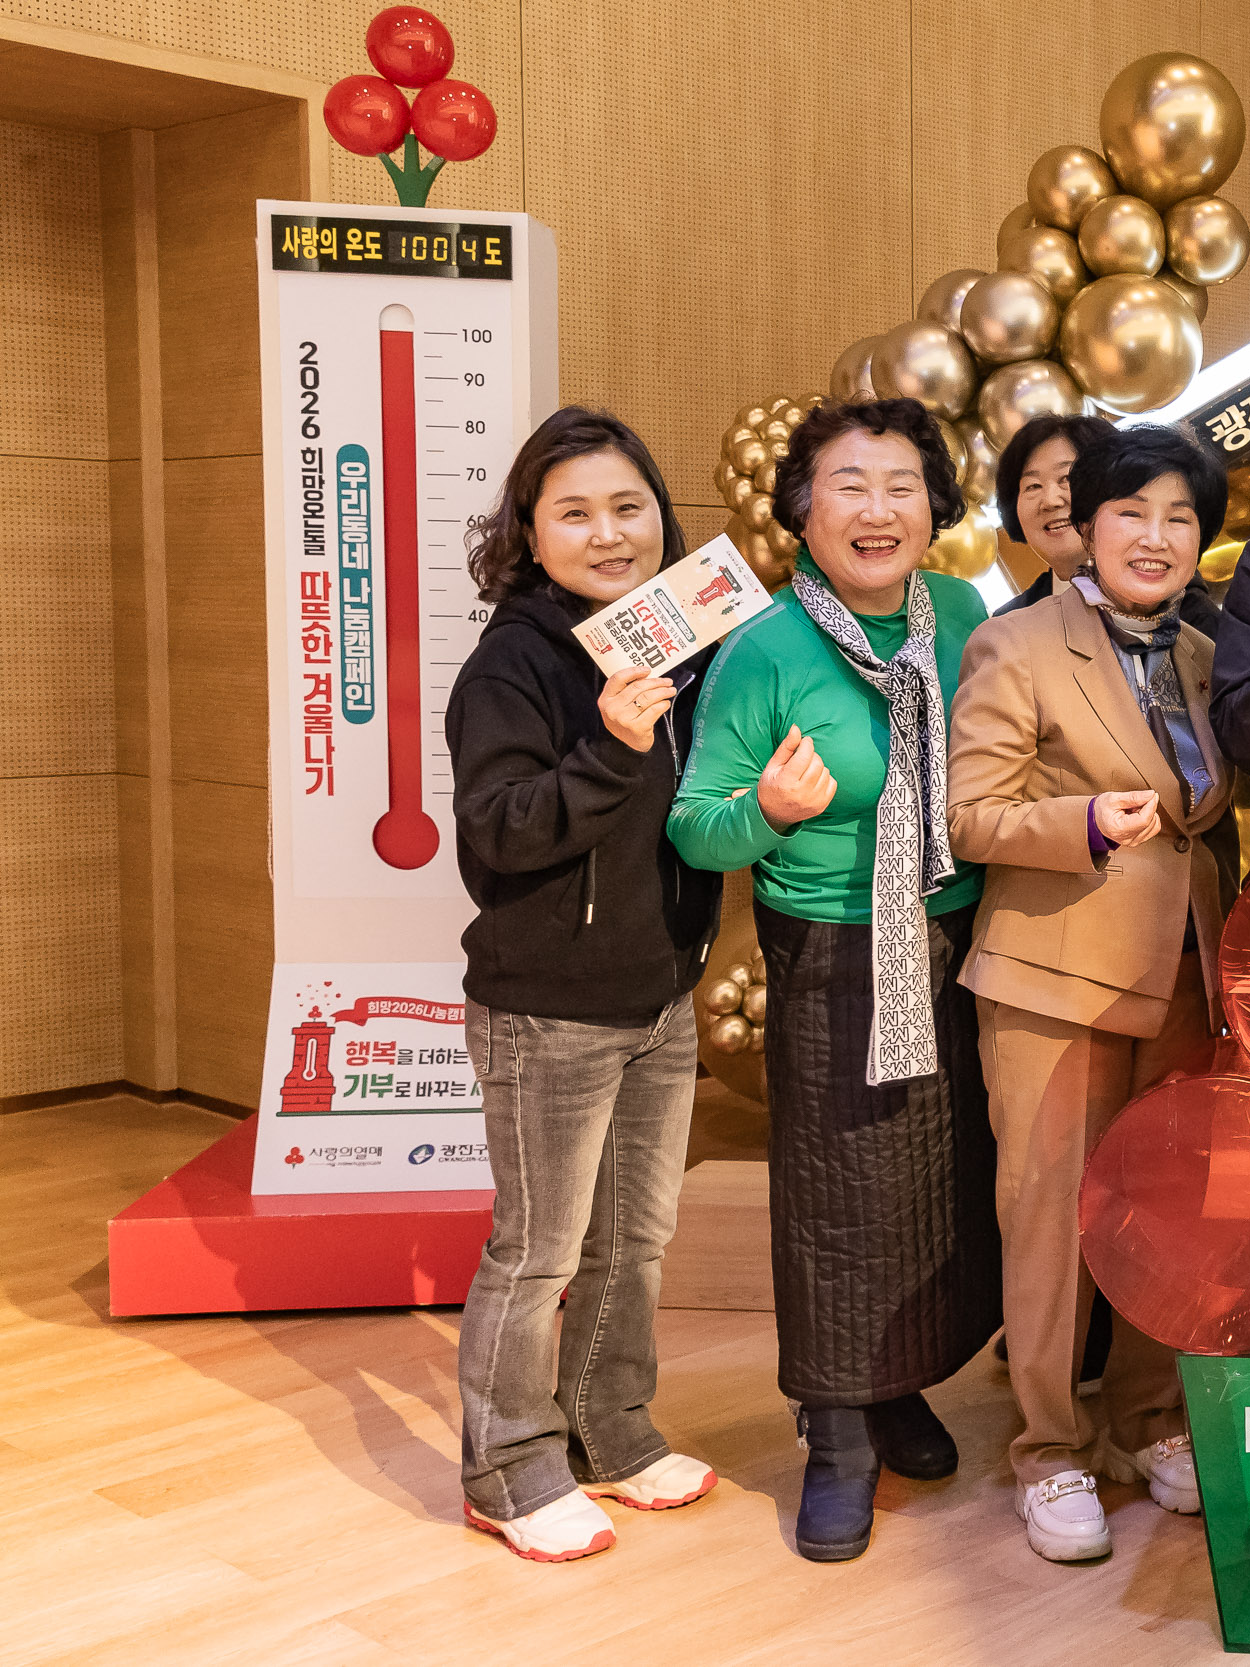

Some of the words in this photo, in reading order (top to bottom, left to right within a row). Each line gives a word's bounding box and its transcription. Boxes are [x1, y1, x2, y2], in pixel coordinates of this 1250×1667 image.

[282, 226, 337, 260] 사랑의
[345, 229, 382, 261] 온도
[462, 329, 492, 343] 100
[299, 341, 321, 439] 2026
[464, 373, 485, 387] 90
[465, 420, 486, 434] 80
[466, 468, 487, 482] 70
[300, 447, 325, 556] 희망온돌
[340, 461, 369, 570] 우리동네
[467, 515, 486, 528] 60
[301, 571, 332, 664] 따뜻한
[468, 609, 489, 623] 40
[631, 598, 679, 657] 겨울나기
[342, 577, 372, 711] 나눔캠페인
[612, 605, 666, 670] 따뜻한
[627, 651, 645, 670] 026
[303, 673, 335, 796] 겨울나기
[367, 1000, 465, 1021] 희망2026나눔캠
[346, 1041, 413, 1067] 행복을
[418, 1048, 468, 1065] 더하는
[343, 1073, 411, 1099] 기부로
[416, 1081, 466, 1097] 바꾸는
[440, 1144, 488, 1157] 광진구
